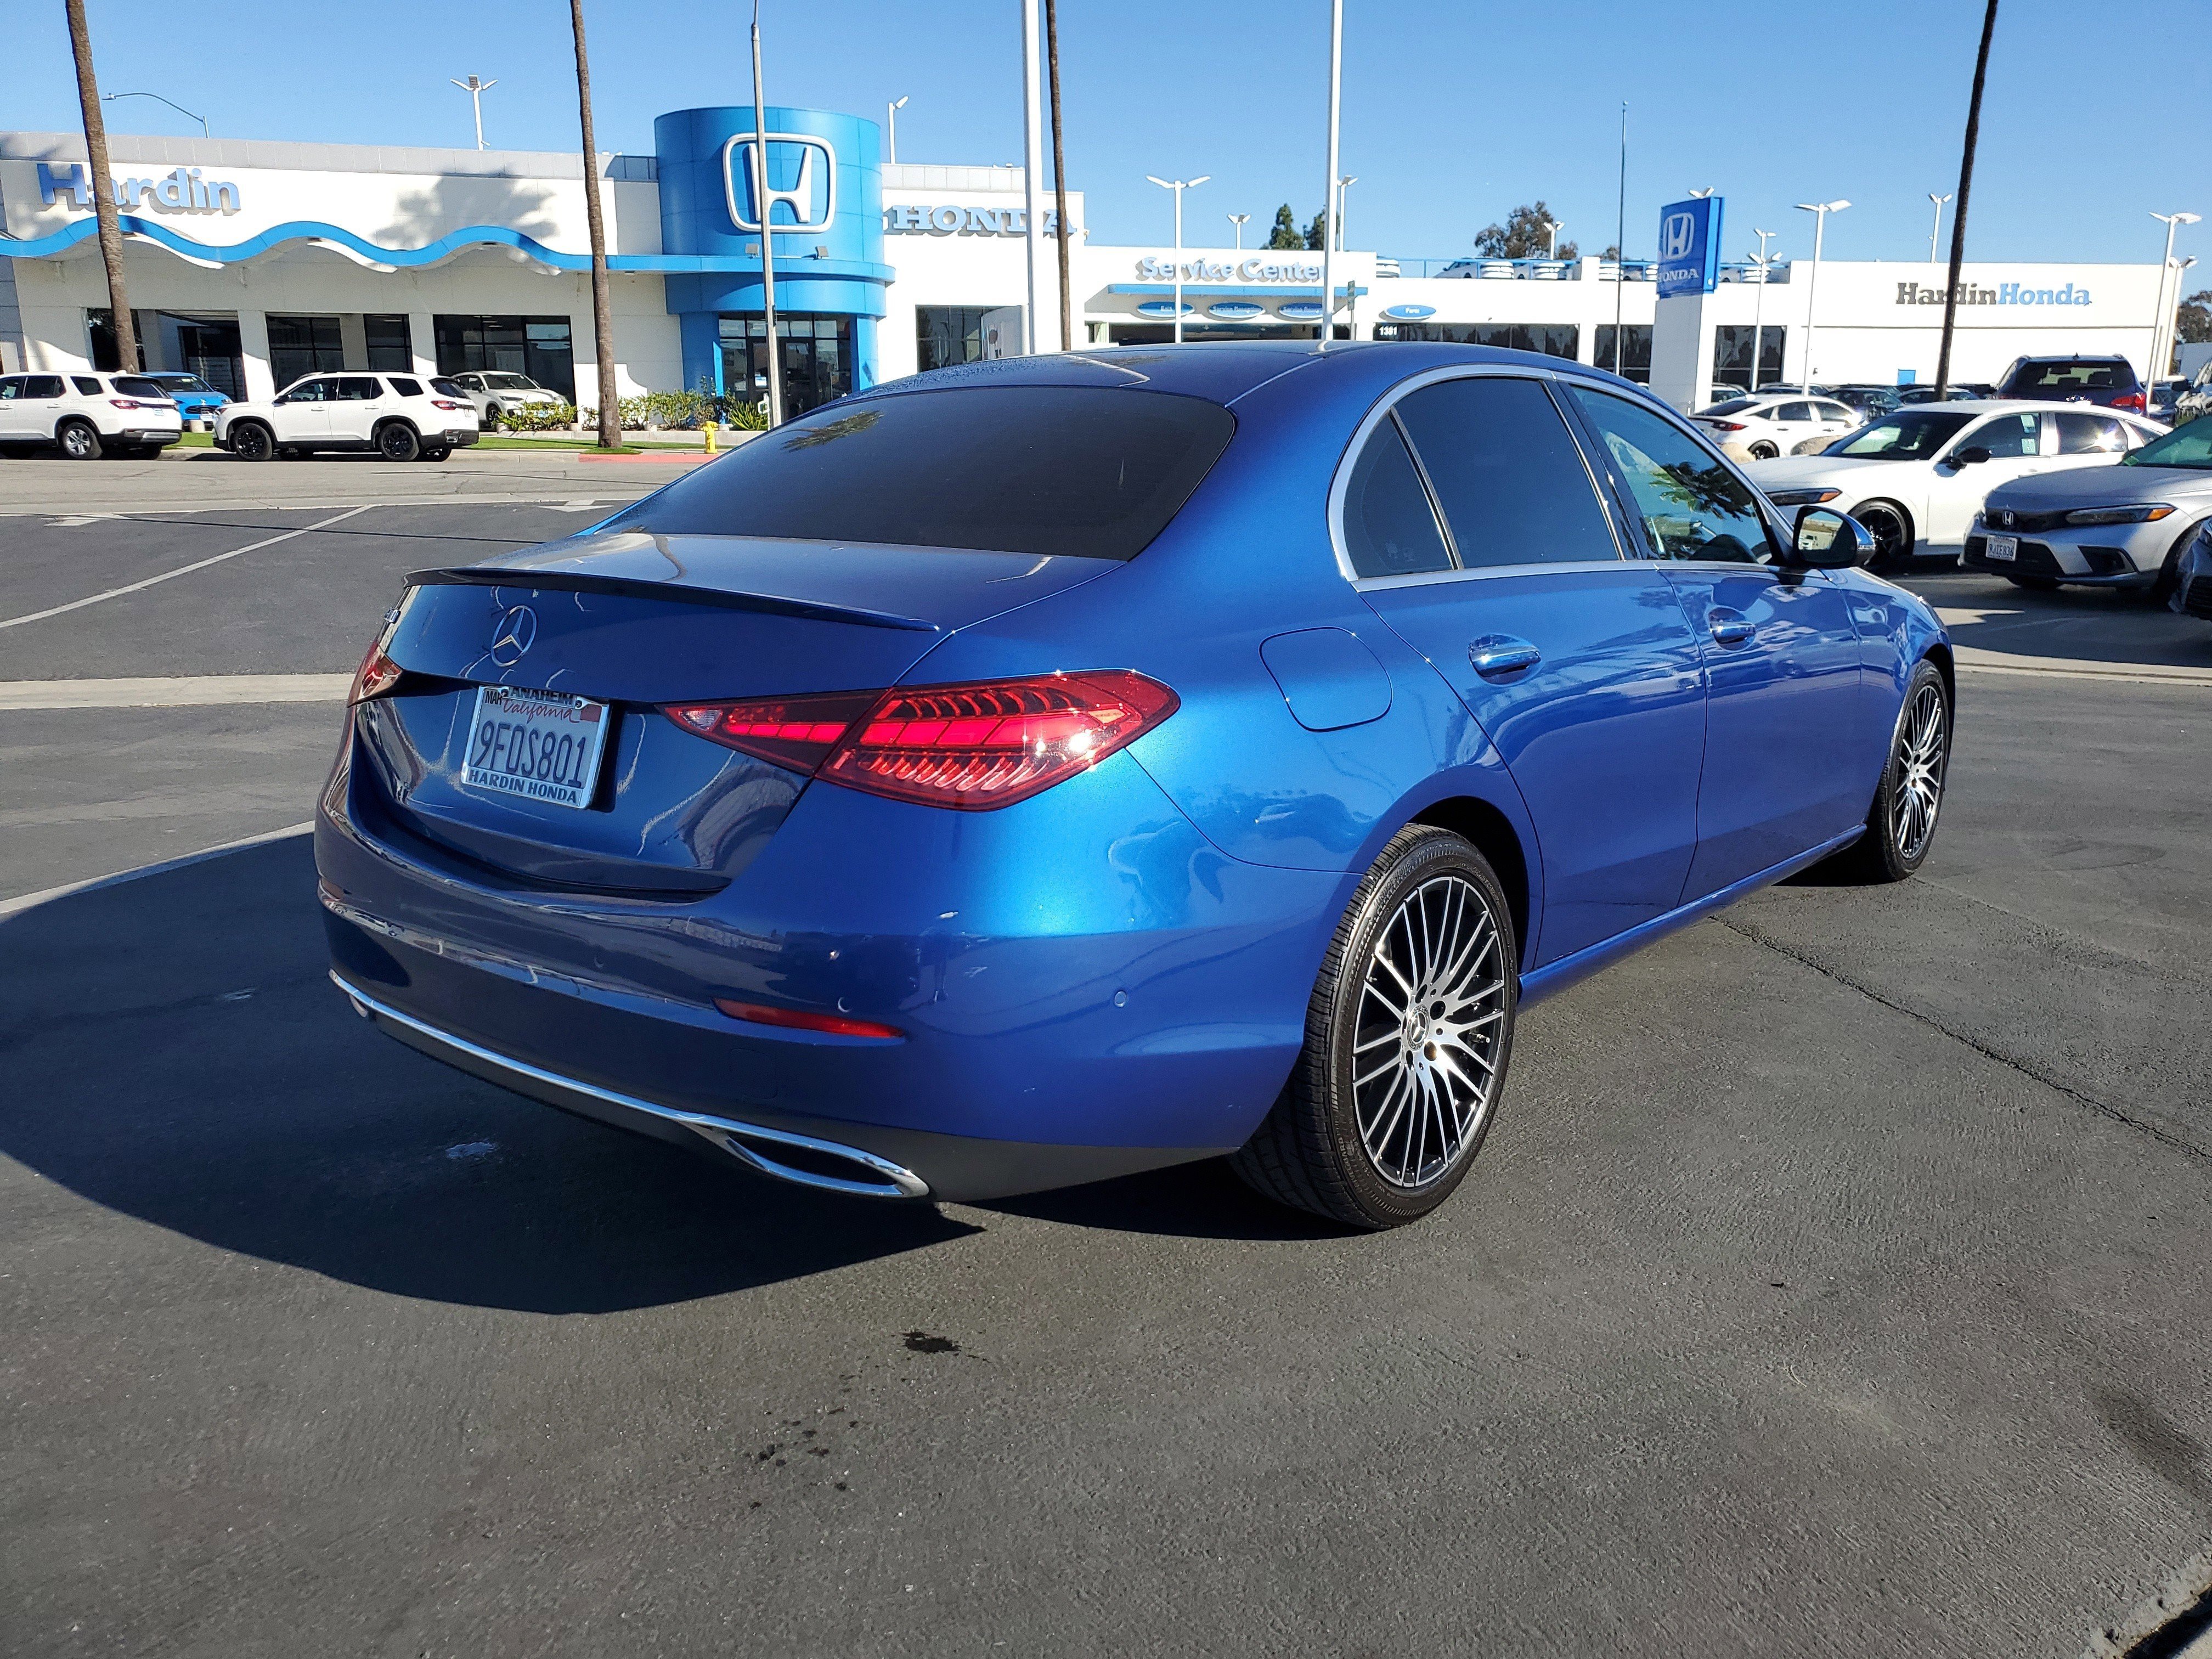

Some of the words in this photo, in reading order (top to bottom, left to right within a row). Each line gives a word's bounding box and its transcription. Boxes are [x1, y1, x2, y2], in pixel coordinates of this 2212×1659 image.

[36, 163, 240, 210] Hrdin
[503, 699, 580, 724] California
[511, 687, 574, 706] ANAHEIM
[474, 720, 586, 788] 9FOS801
[468, 769, 525, 792] HARDIN
[527, 781, 577, 803] HONDA
